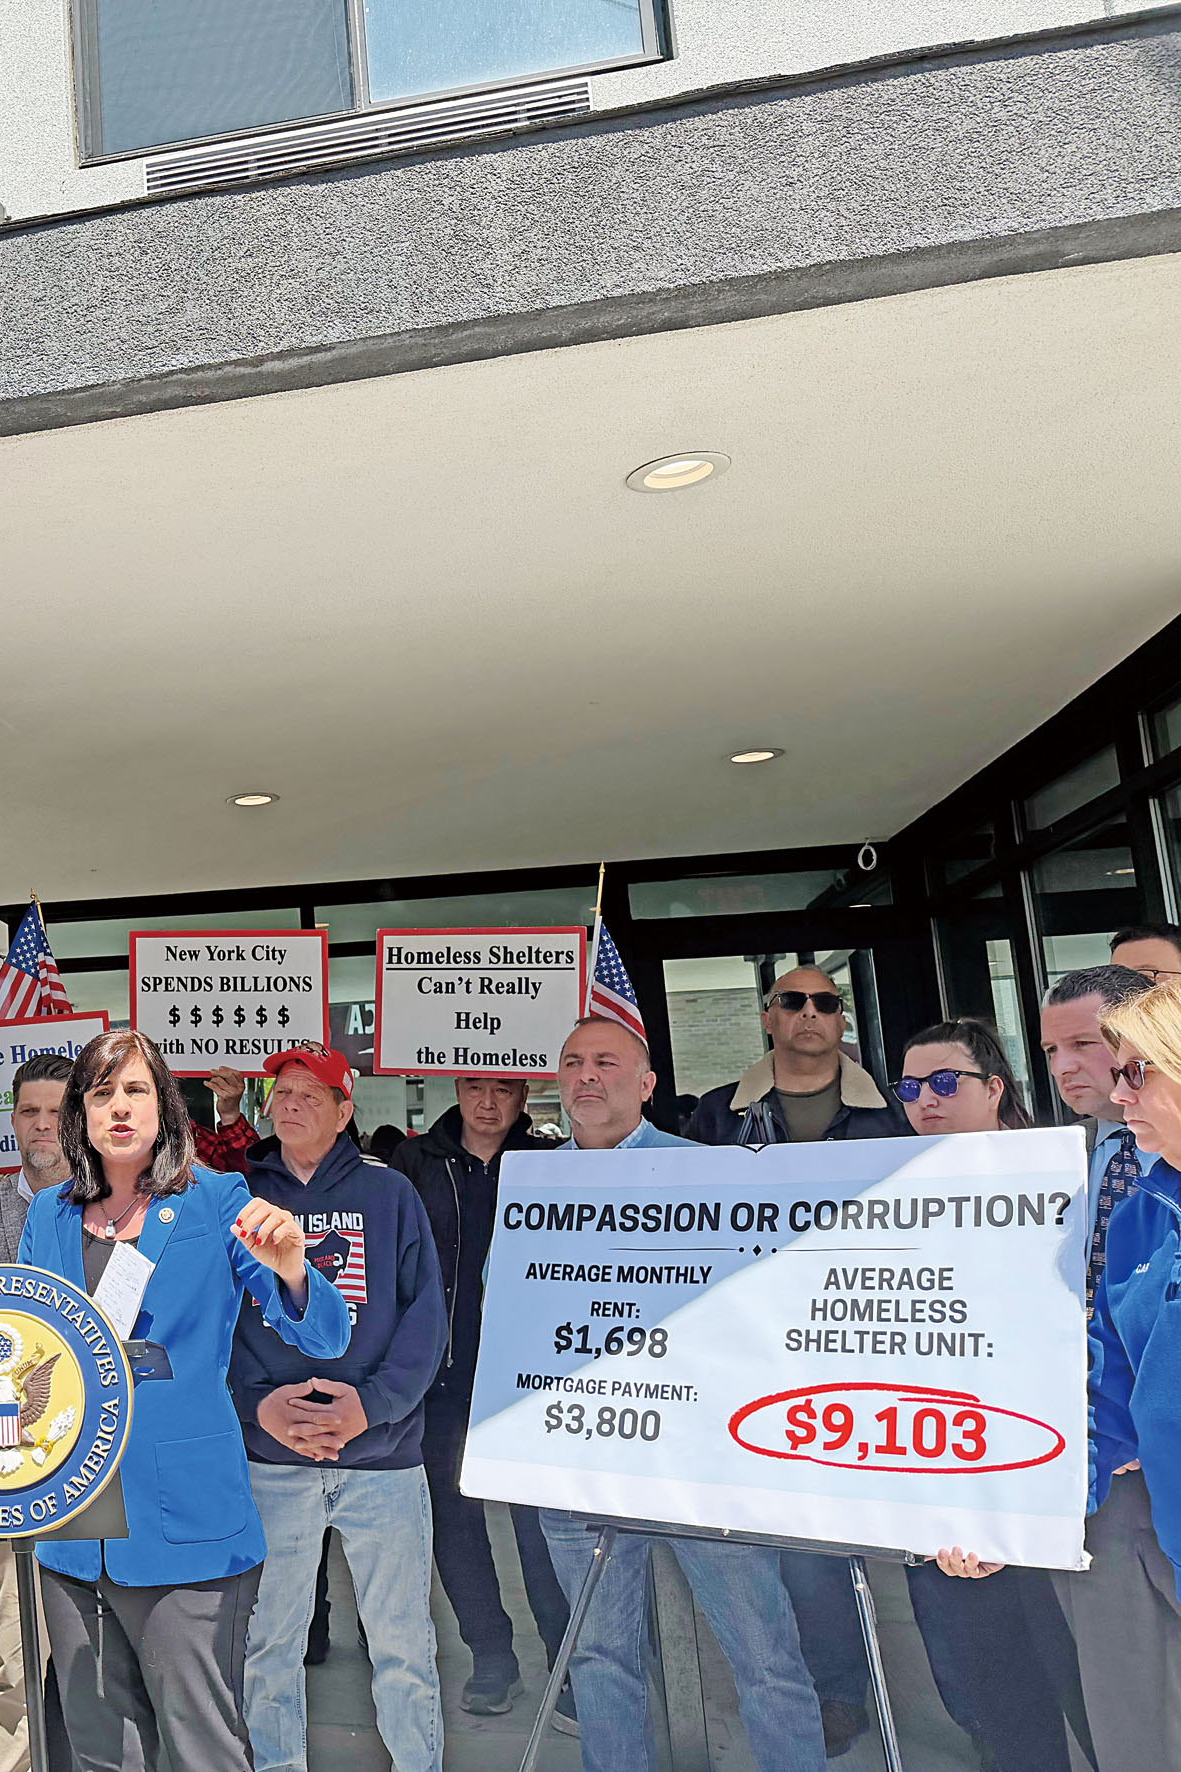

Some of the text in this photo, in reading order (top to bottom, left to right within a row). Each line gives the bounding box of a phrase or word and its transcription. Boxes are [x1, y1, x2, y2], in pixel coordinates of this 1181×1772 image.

[165, 944, 287, 965] New York City
[386, 945, 575, 965] Homeless Shelters
[141, 976, 313, 993] SPENDS BILLIONS
[478, 976, 543, 1000] Really
[168, 1004, 290, 1028] $ $ $ $ $ $
[454, 1011, 502, 1035] Help
[10, 1040, 84, 1065] Homele
[190, 1038, 219, 1055] NO
[416, 1046, 548, 1068] the Homeless
[308, 1211, 364, 1233] ISLAND
[503, 1191, 1072, 1233] COMPASSION OR CORRUPTION?
[525, 1262, 713, 1285] AVERAGE MONTHLY
[823, 1266, 954, 1291] AVERAGE
[590, 1300, 641, 1319] RENT:
[811, 1298, 968, 1324] HOMELESS
[553, 1321, 669, 1359] $1,698
[785, 1328, 994, 1358] SHELTER UNIT:
[516, 1373, 699, 1402] MORTGAGE PAYMENT:
[544, 1400, 662, 1442] $3,800
[785, 1398, 988, 1462] $9,103
[30, 1492, 59, 1521] OF
[63, 1397, 120, 1504] AMERICA
